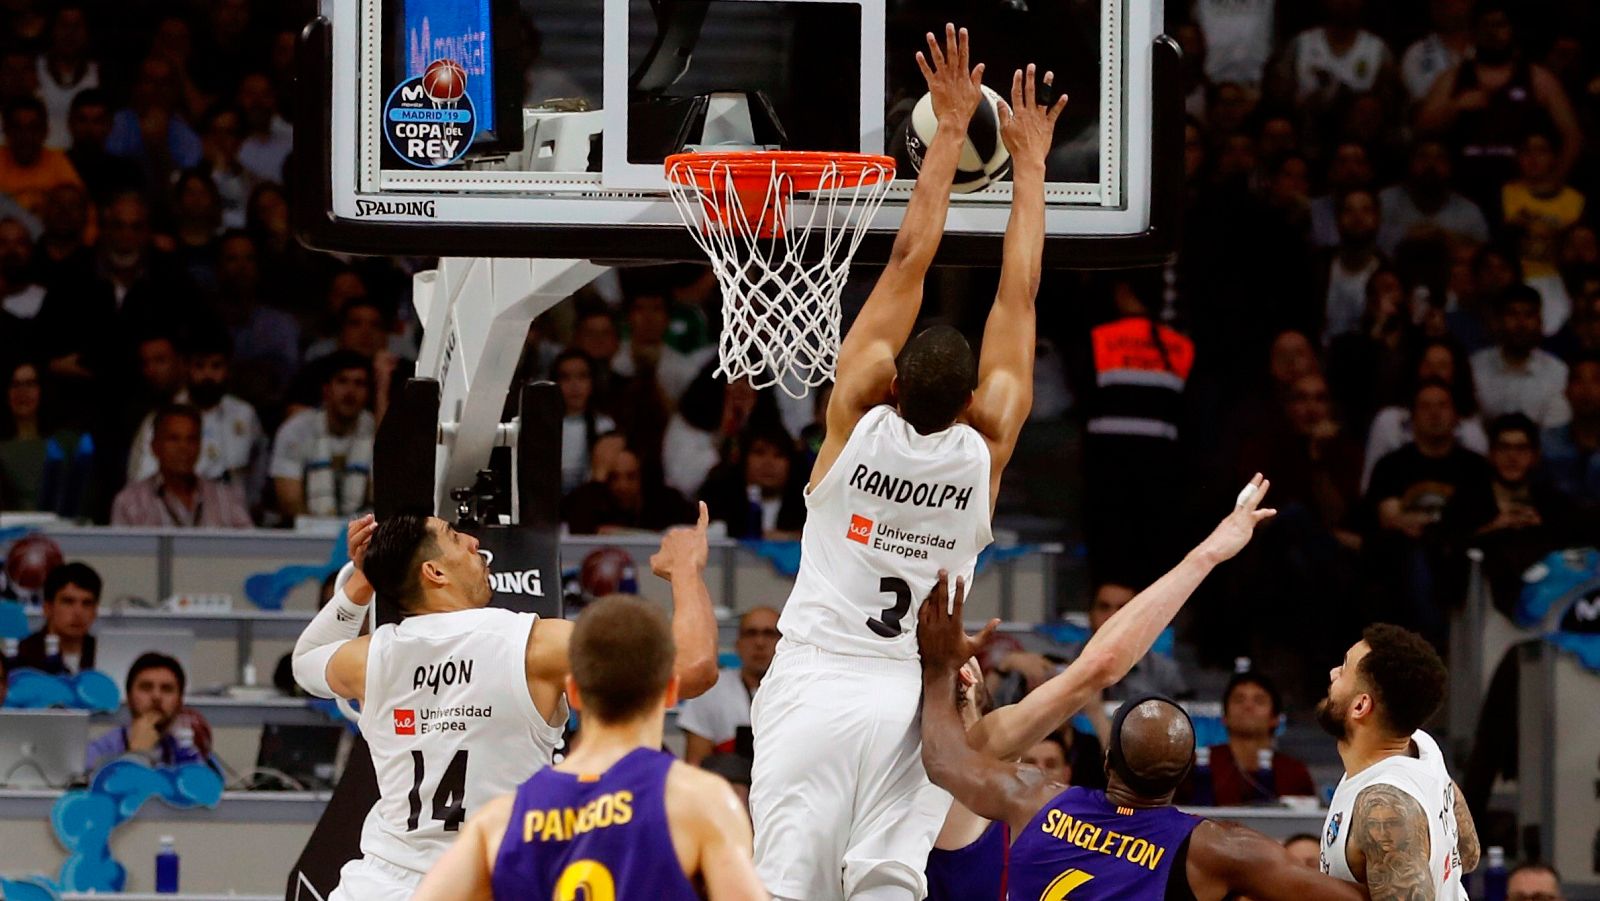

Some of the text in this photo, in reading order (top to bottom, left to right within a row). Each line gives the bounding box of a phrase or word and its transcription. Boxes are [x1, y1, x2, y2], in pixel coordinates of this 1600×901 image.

[402, 110, 459, 120] MADRID '19
[395, 123, 464, 138] COPA DEL
[407, 138, 460, 158] REY
[355, 199, 435, 218] SPALDING
[849, 463, 973, 511] RANDOLPH
[873, 538, 929, 560] Europea
[877, 523, 956, 550] Universidad
[866, 576, 912, 638] 3
[413, 655, 474, 695] AYÓN
[420, 705, 492, 720] Universidad
[406, 749, 469, 832] 14
[523, 790, 634, 843] PANGOS
[1041, 808, 1165, 871] SINGLETON
